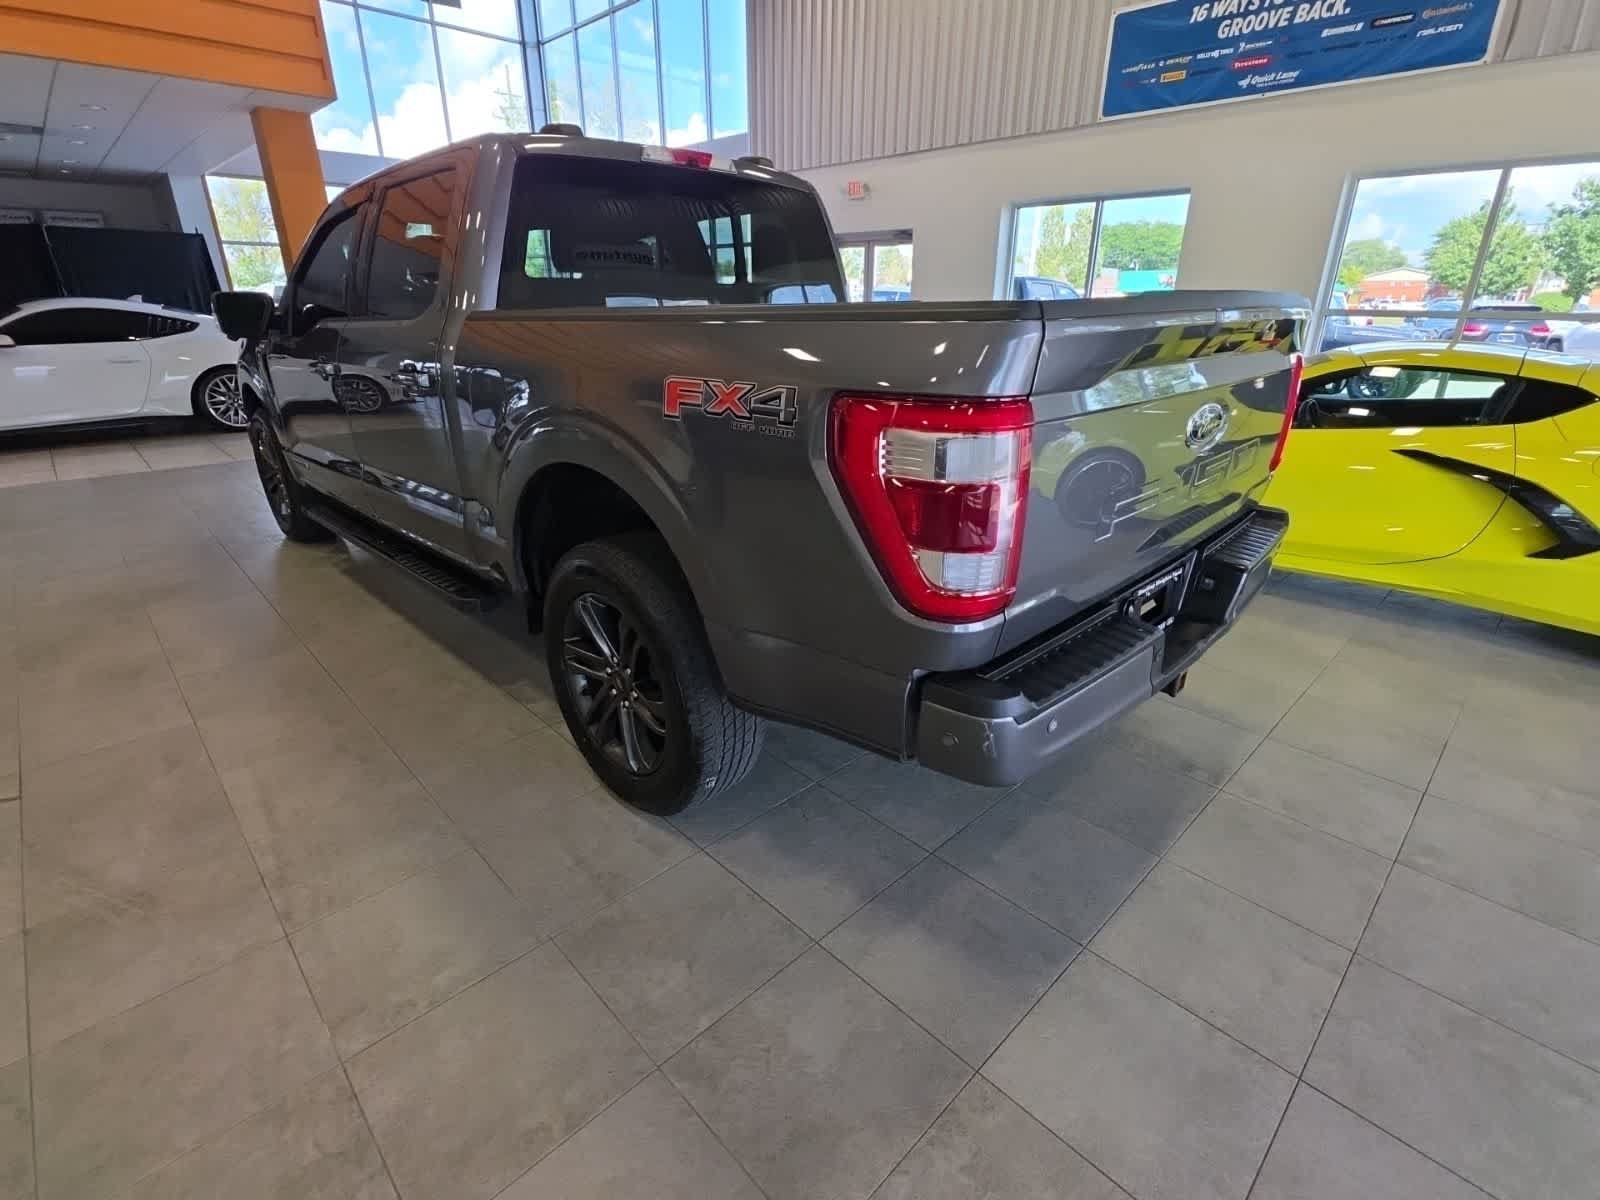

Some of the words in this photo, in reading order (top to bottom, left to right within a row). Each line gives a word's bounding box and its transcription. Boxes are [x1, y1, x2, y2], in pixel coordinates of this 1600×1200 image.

[1190, 4, 1210, 24] 16
[1211, 0, 1261, 18] WAYS
[1218, 6, 1294, 39] GROOVE
[1294, 0, 1351, 24] BACK.
[664, 375, 798, 428] FX4
